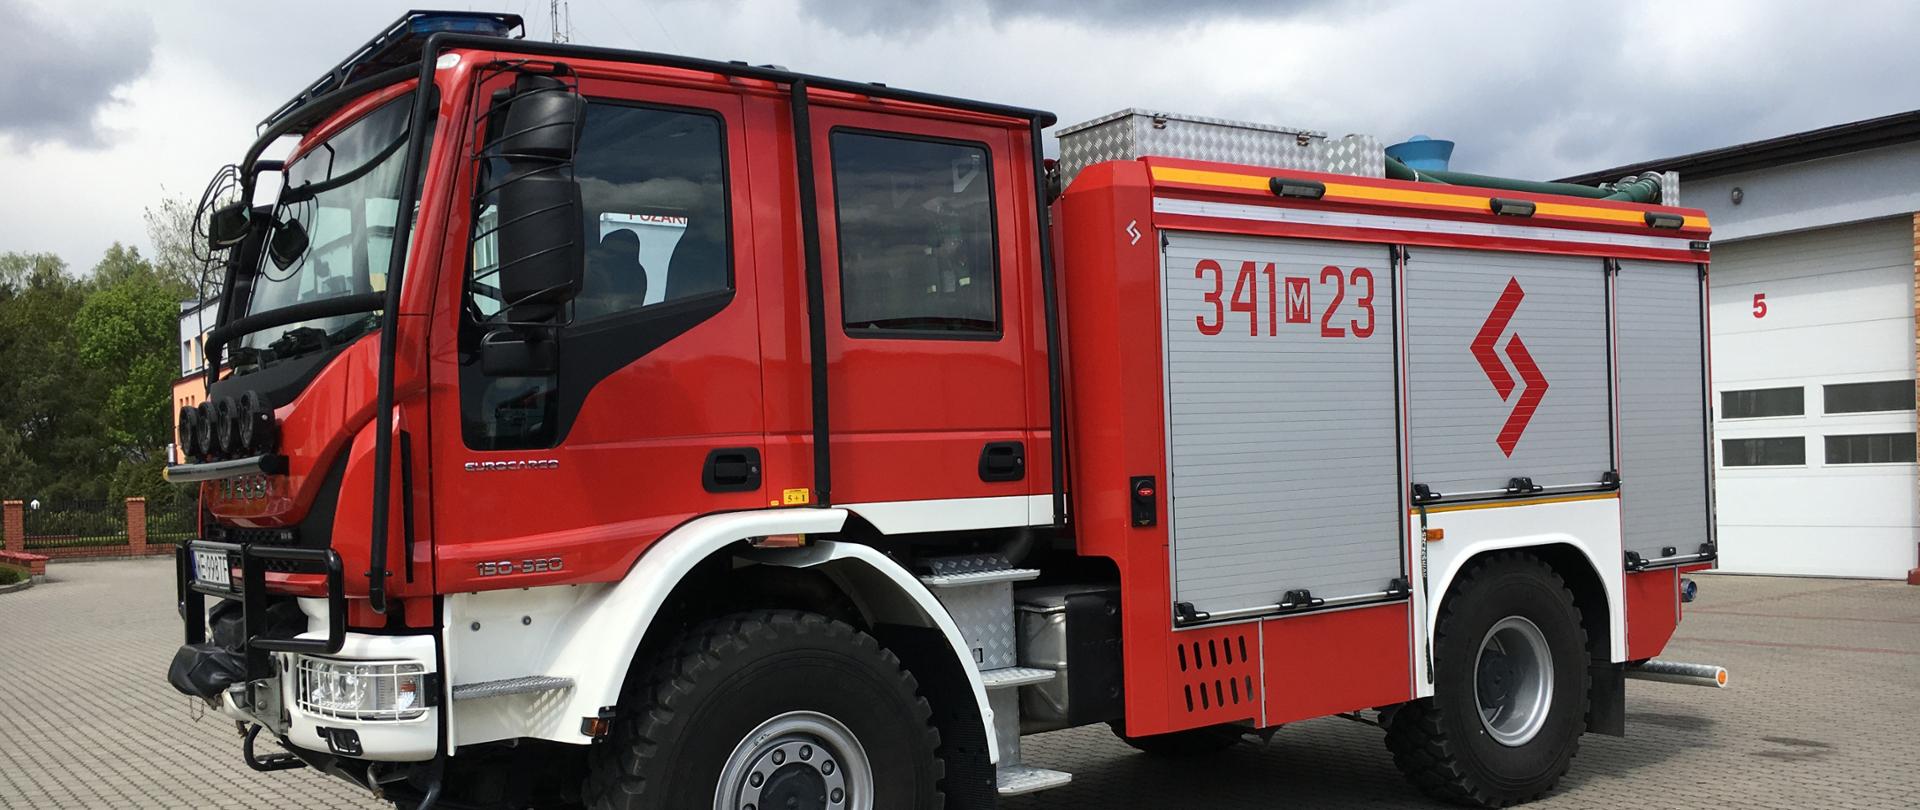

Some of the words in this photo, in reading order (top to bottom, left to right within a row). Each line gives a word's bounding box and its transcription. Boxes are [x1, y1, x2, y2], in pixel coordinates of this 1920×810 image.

[1195, 259, 1277, 337] 341
[1286, 278, 1311, 323] M
[1320, 265, 1375, 338] 23
[1752, 293, 1767, 318] 5
